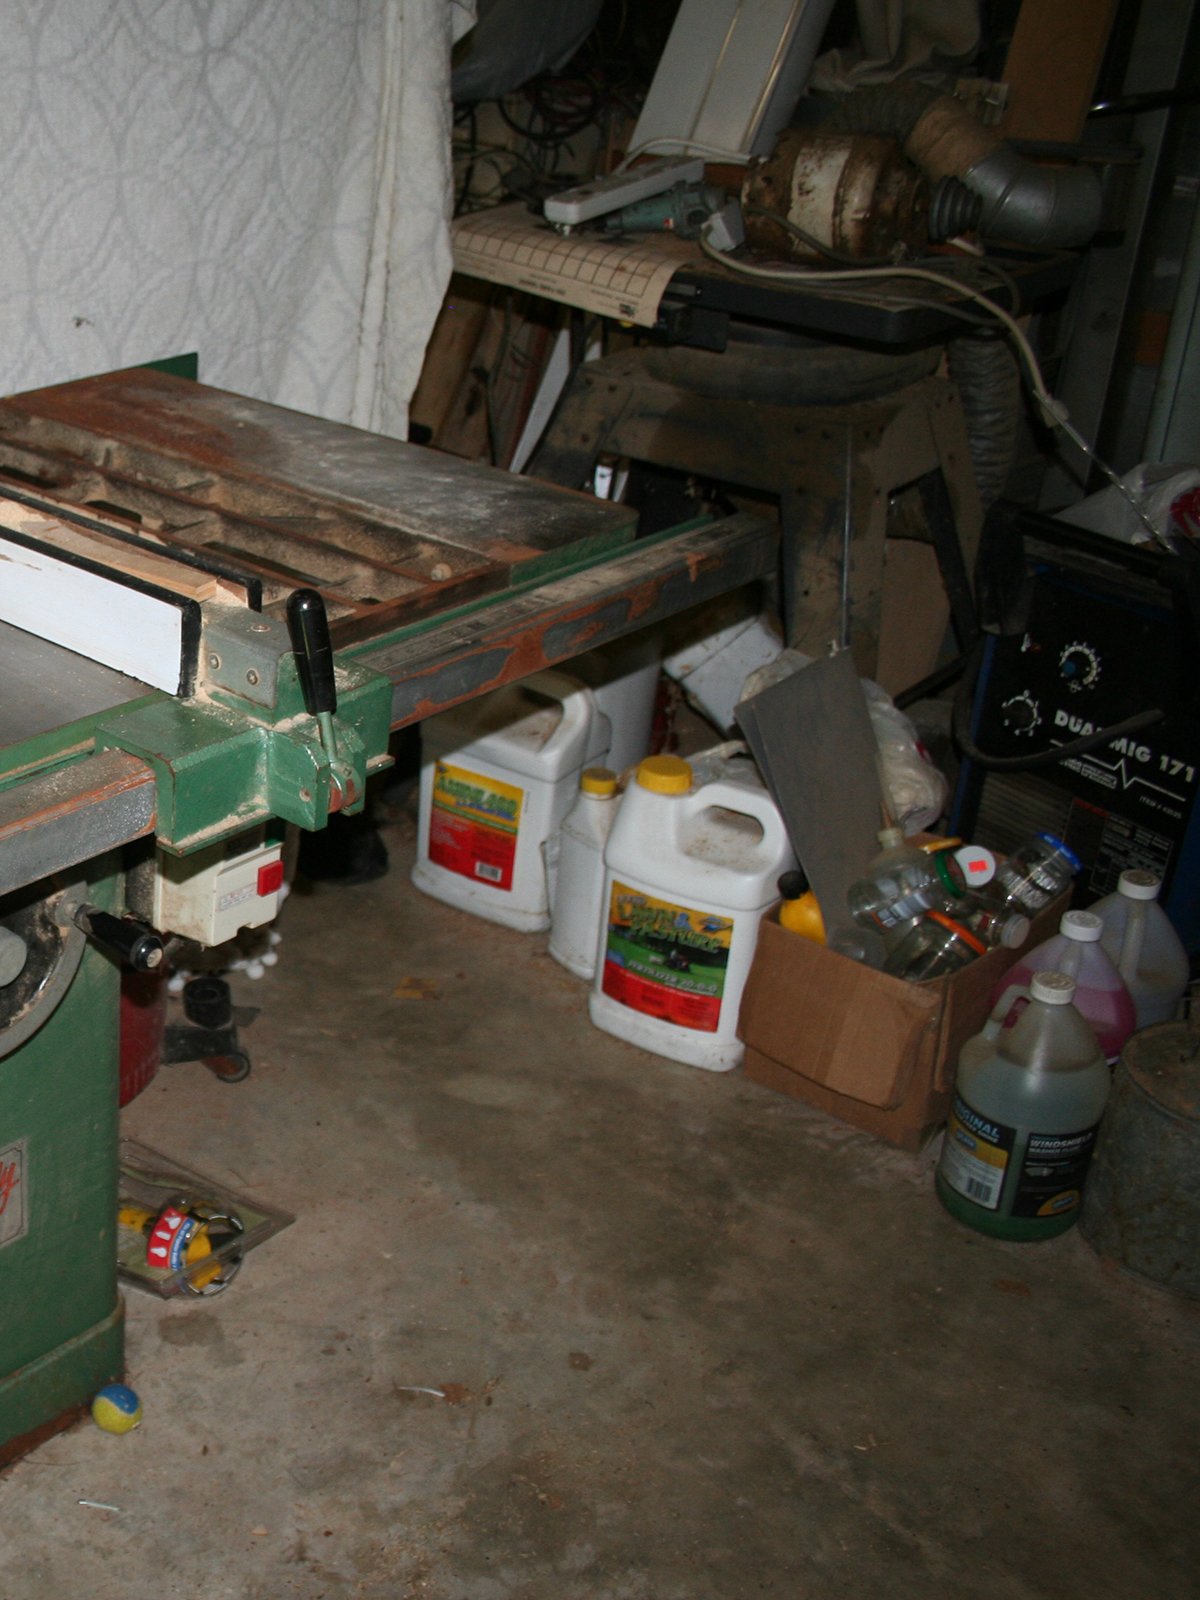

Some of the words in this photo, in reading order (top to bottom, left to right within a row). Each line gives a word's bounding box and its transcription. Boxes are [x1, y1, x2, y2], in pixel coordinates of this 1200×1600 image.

[1054, 709, 1103, 737] DUA
[1109, 737, 1151, 763] MIG
[1159, 755, 1195, 783] 171
